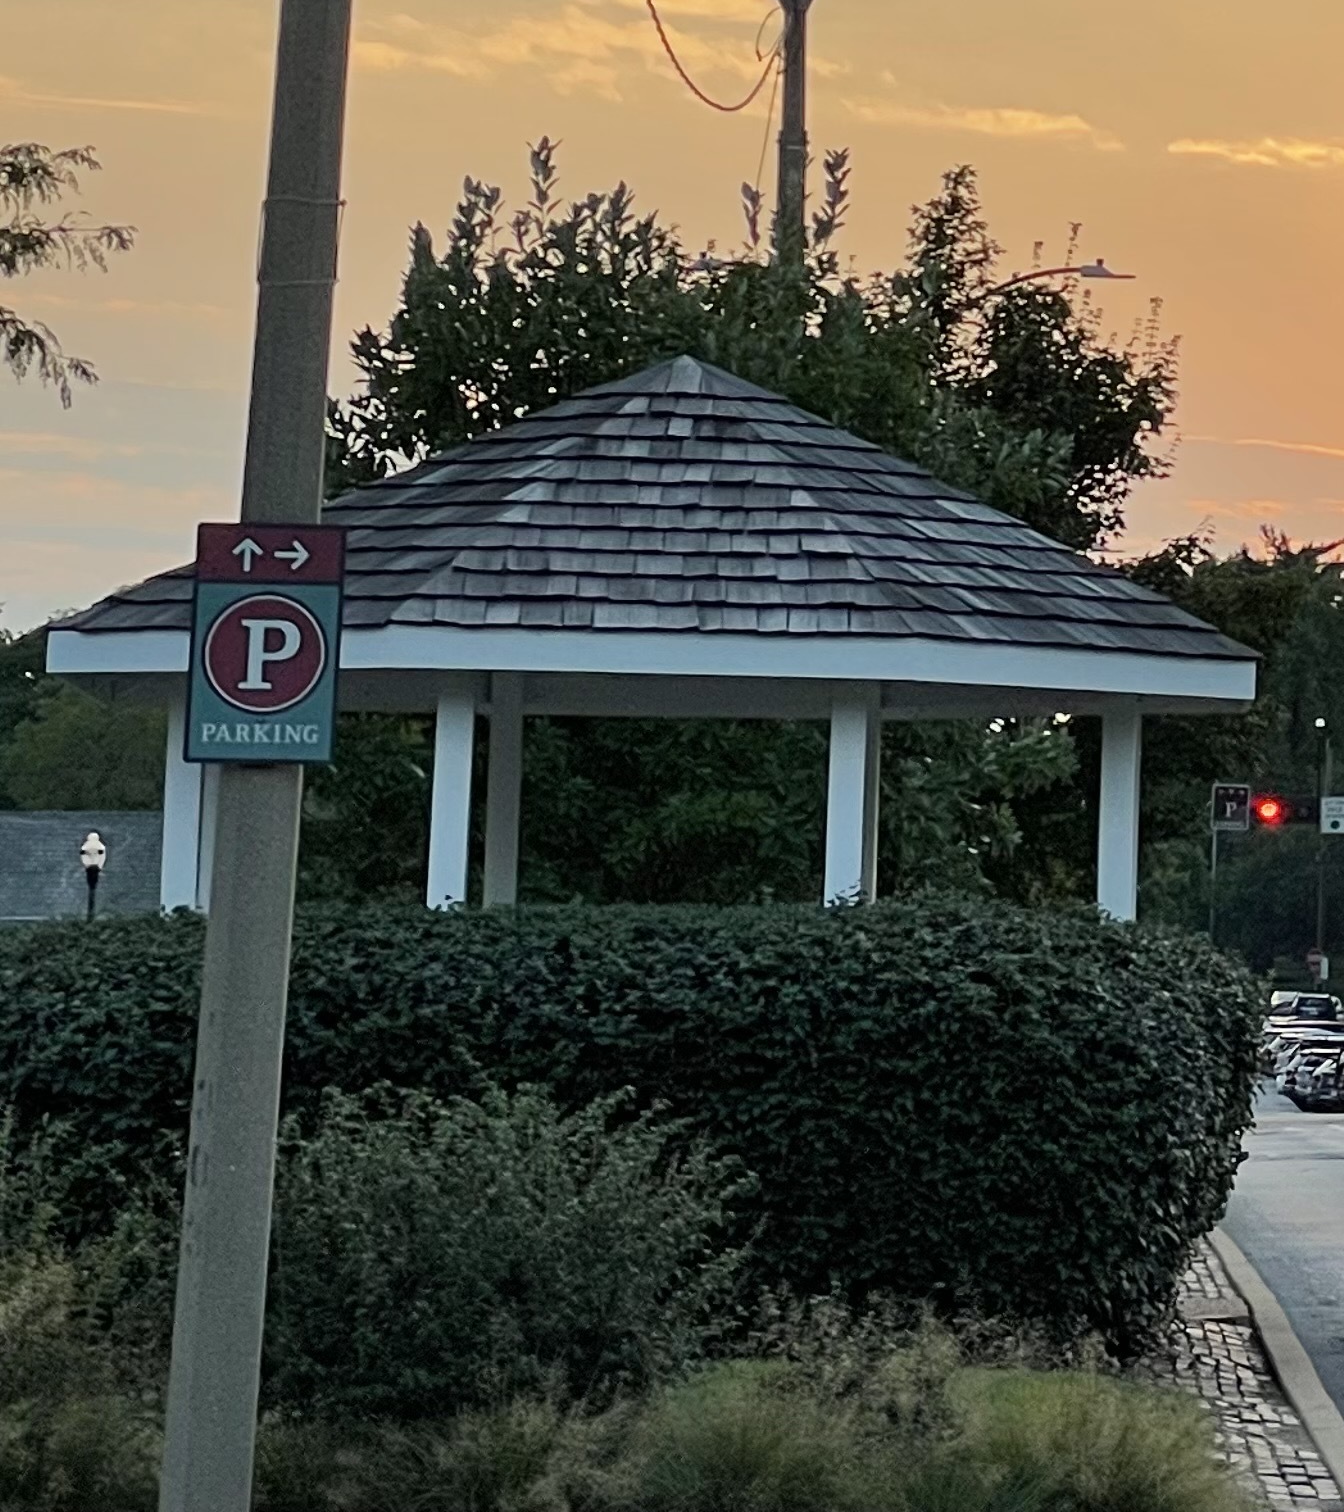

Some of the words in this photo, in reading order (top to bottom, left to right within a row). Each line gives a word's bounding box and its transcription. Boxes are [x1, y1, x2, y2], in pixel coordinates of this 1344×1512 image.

[238, 618, 302, 690] P
[201, 722, 320, 745] PARKING
[1225, 801, 1238, 818] P
